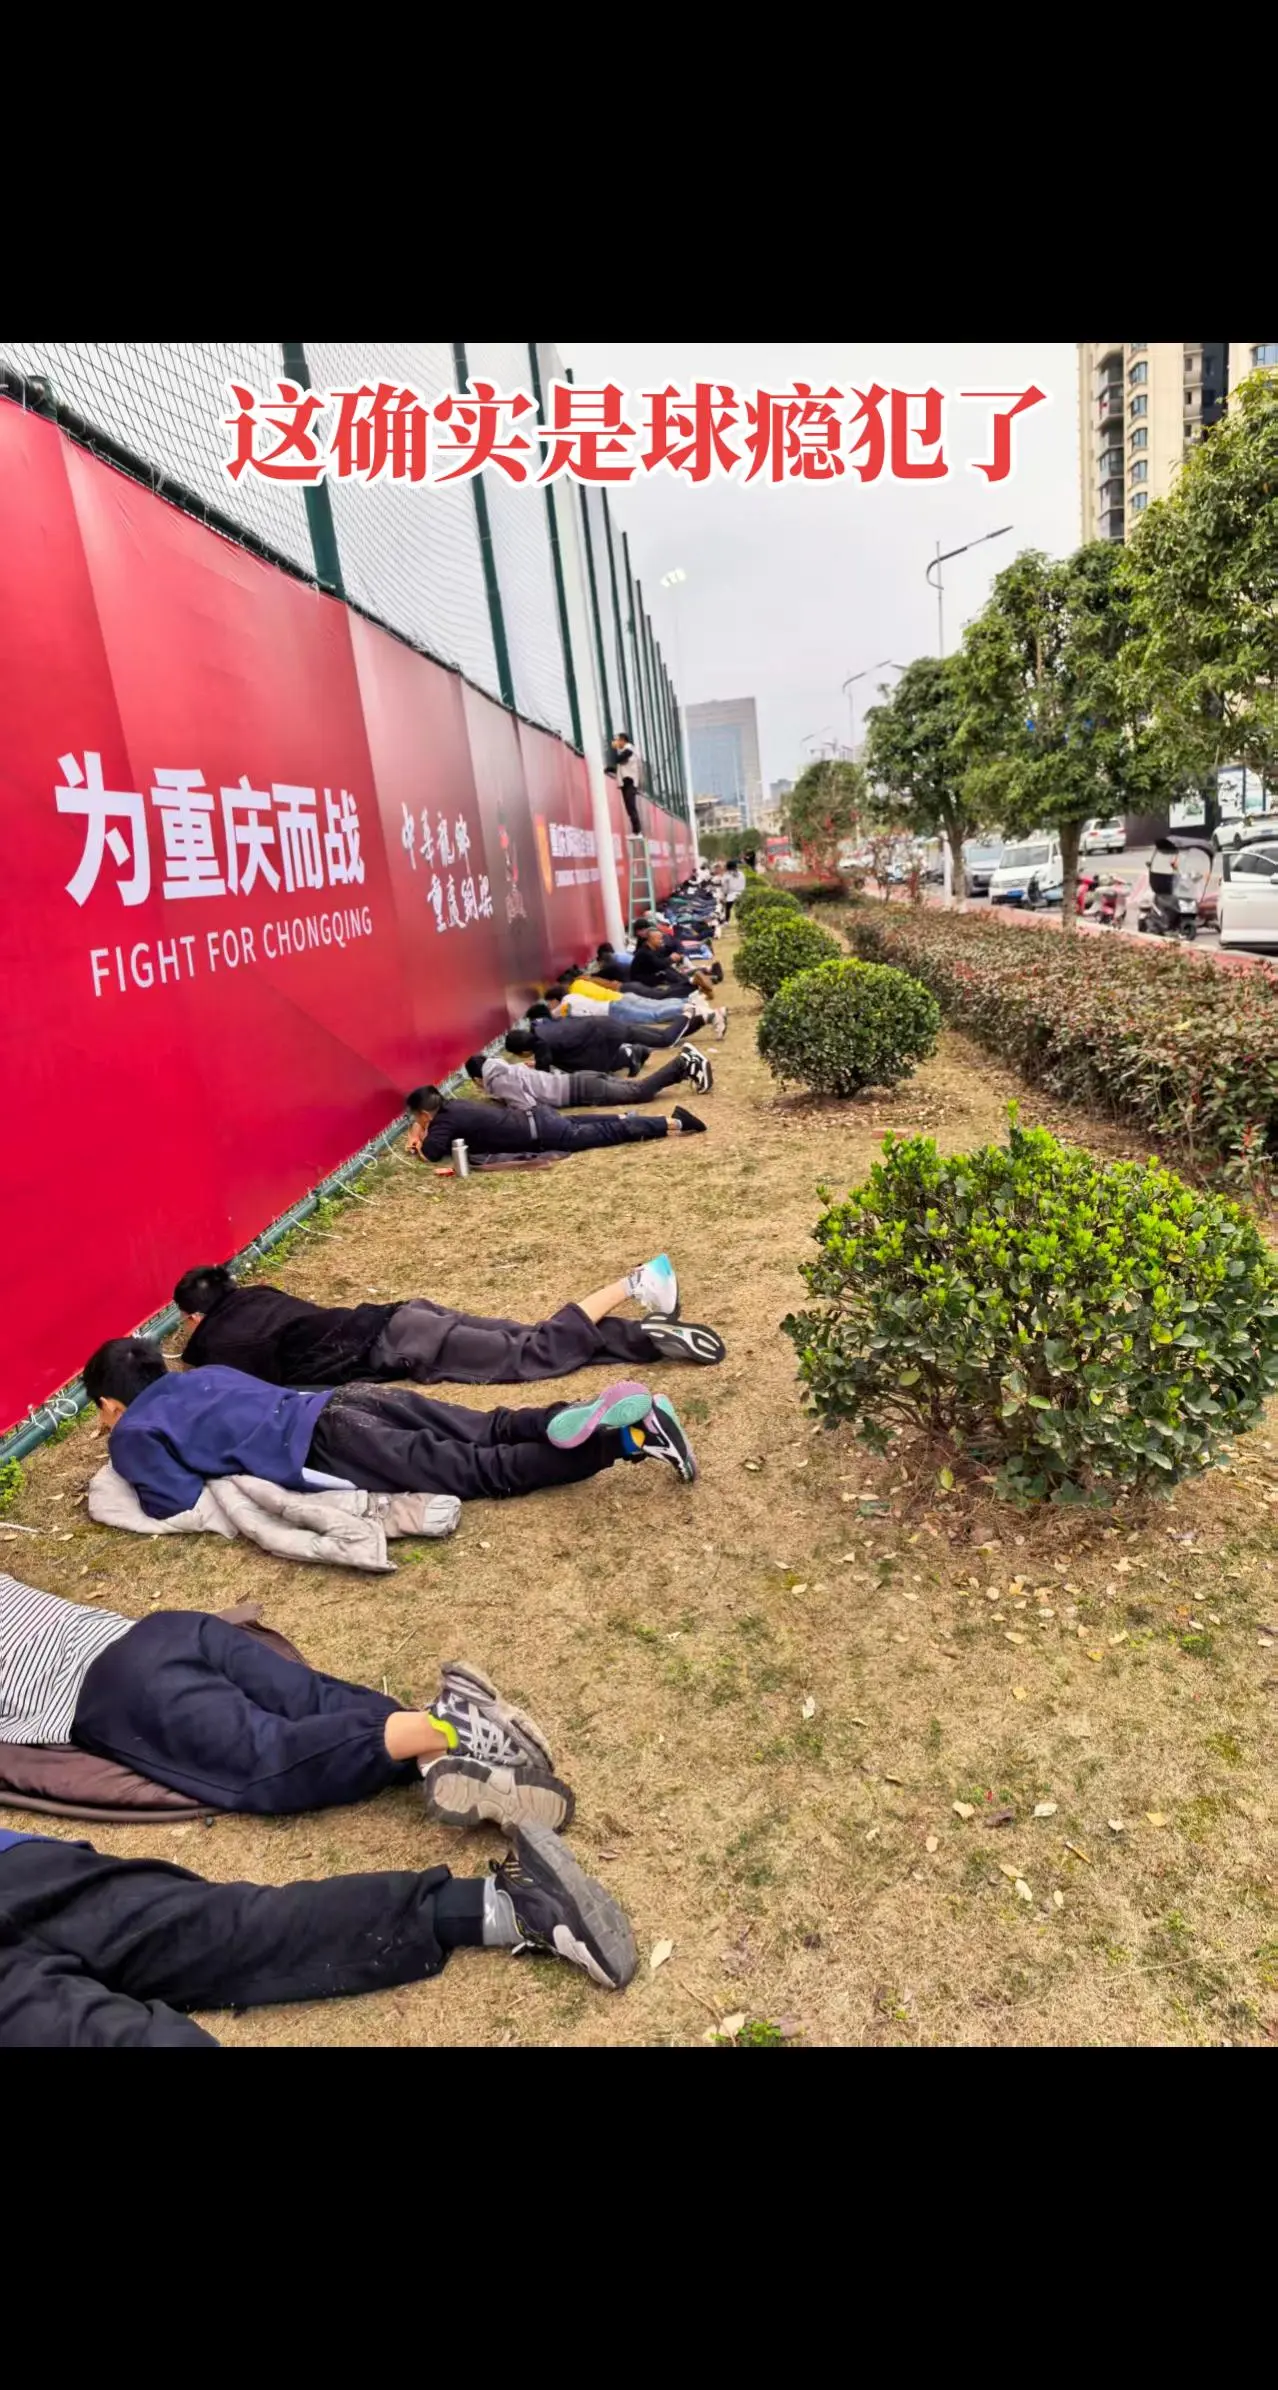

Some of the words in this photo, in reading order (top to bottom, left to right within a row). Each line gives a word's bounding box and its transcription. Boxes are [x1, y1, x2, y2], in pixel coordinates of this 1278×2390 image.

[54, 751, 365, 907] 为重庆而战
[90, 936, 197, 996] FIGHT
[207, 927, 256, 972] FOR
[263, 905, 373, 959] CHONGQING
